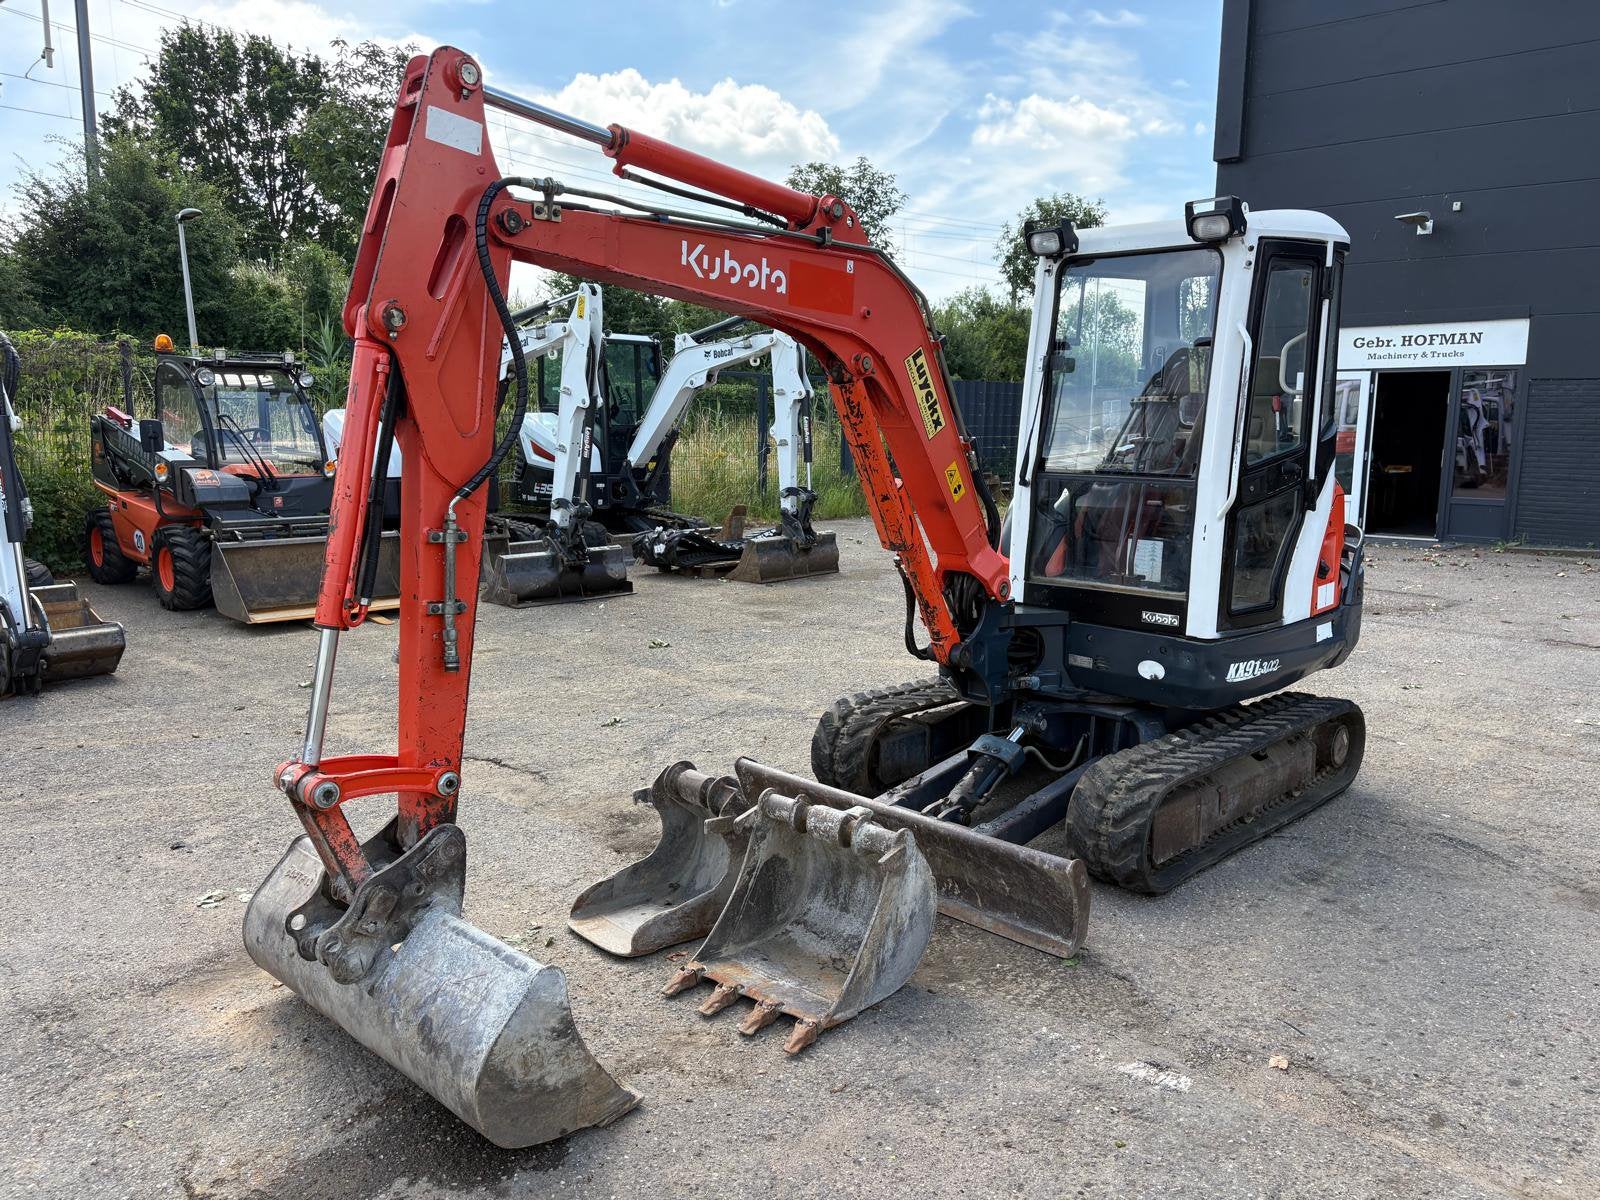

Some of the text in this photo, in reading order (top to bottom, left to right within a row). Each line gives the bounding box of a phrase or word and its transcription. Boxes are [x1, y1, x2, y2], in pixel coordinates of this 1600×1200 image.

[681, 240, 787, 295] Kubota
[1353, 332, 1483, 348] Gebr. HOFMAN
[713, 347, 734, 359] Bobcat
[1430, 350, 1465, 358] Trucks
[911, 349, 943, 432] Luyckx
[135, 533, 144, 550] 20
[1142, 611, 1179, 626] Kubota
